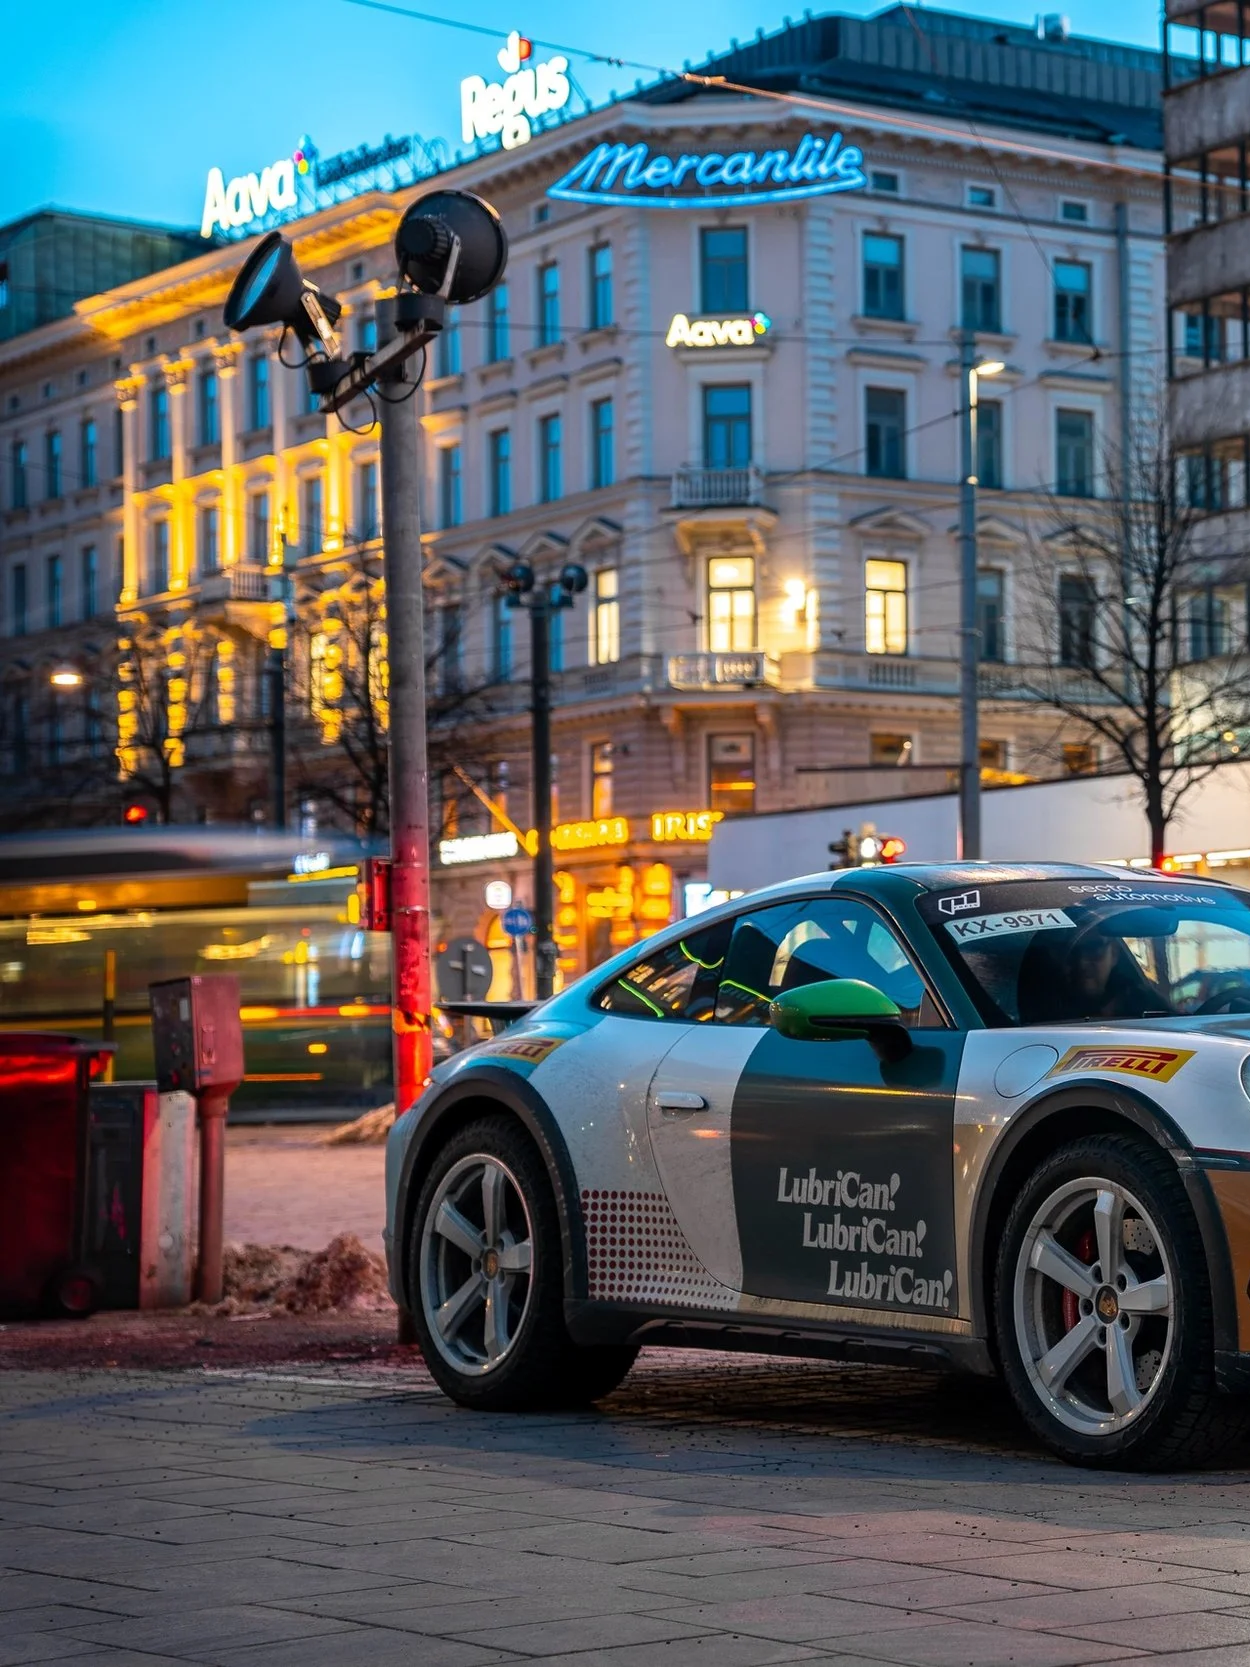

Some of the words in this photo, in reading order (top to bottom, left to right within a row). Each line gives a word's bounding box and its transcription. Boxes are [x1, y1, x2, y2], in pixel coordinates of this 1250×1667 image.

[459, 54, 571, 151] Regus
[548, 131, 866, 195] Mercantile
[200, 159, 298, 239] Aava
[665, 313, 755, 347] Aava
[1067, 883, 1133, 894] secto
[1093, 892, 1216, 905] automotive
[953, 912, 1061, 937] KX-9971
[1059, 1049, 1178, 1075] PIRELLI
[777, 1167, 901, 1211] LubriCan!
[802, 1212, 927, 1258] LubriCan!
[826, 1260, 953, 1308] LubriCan!
